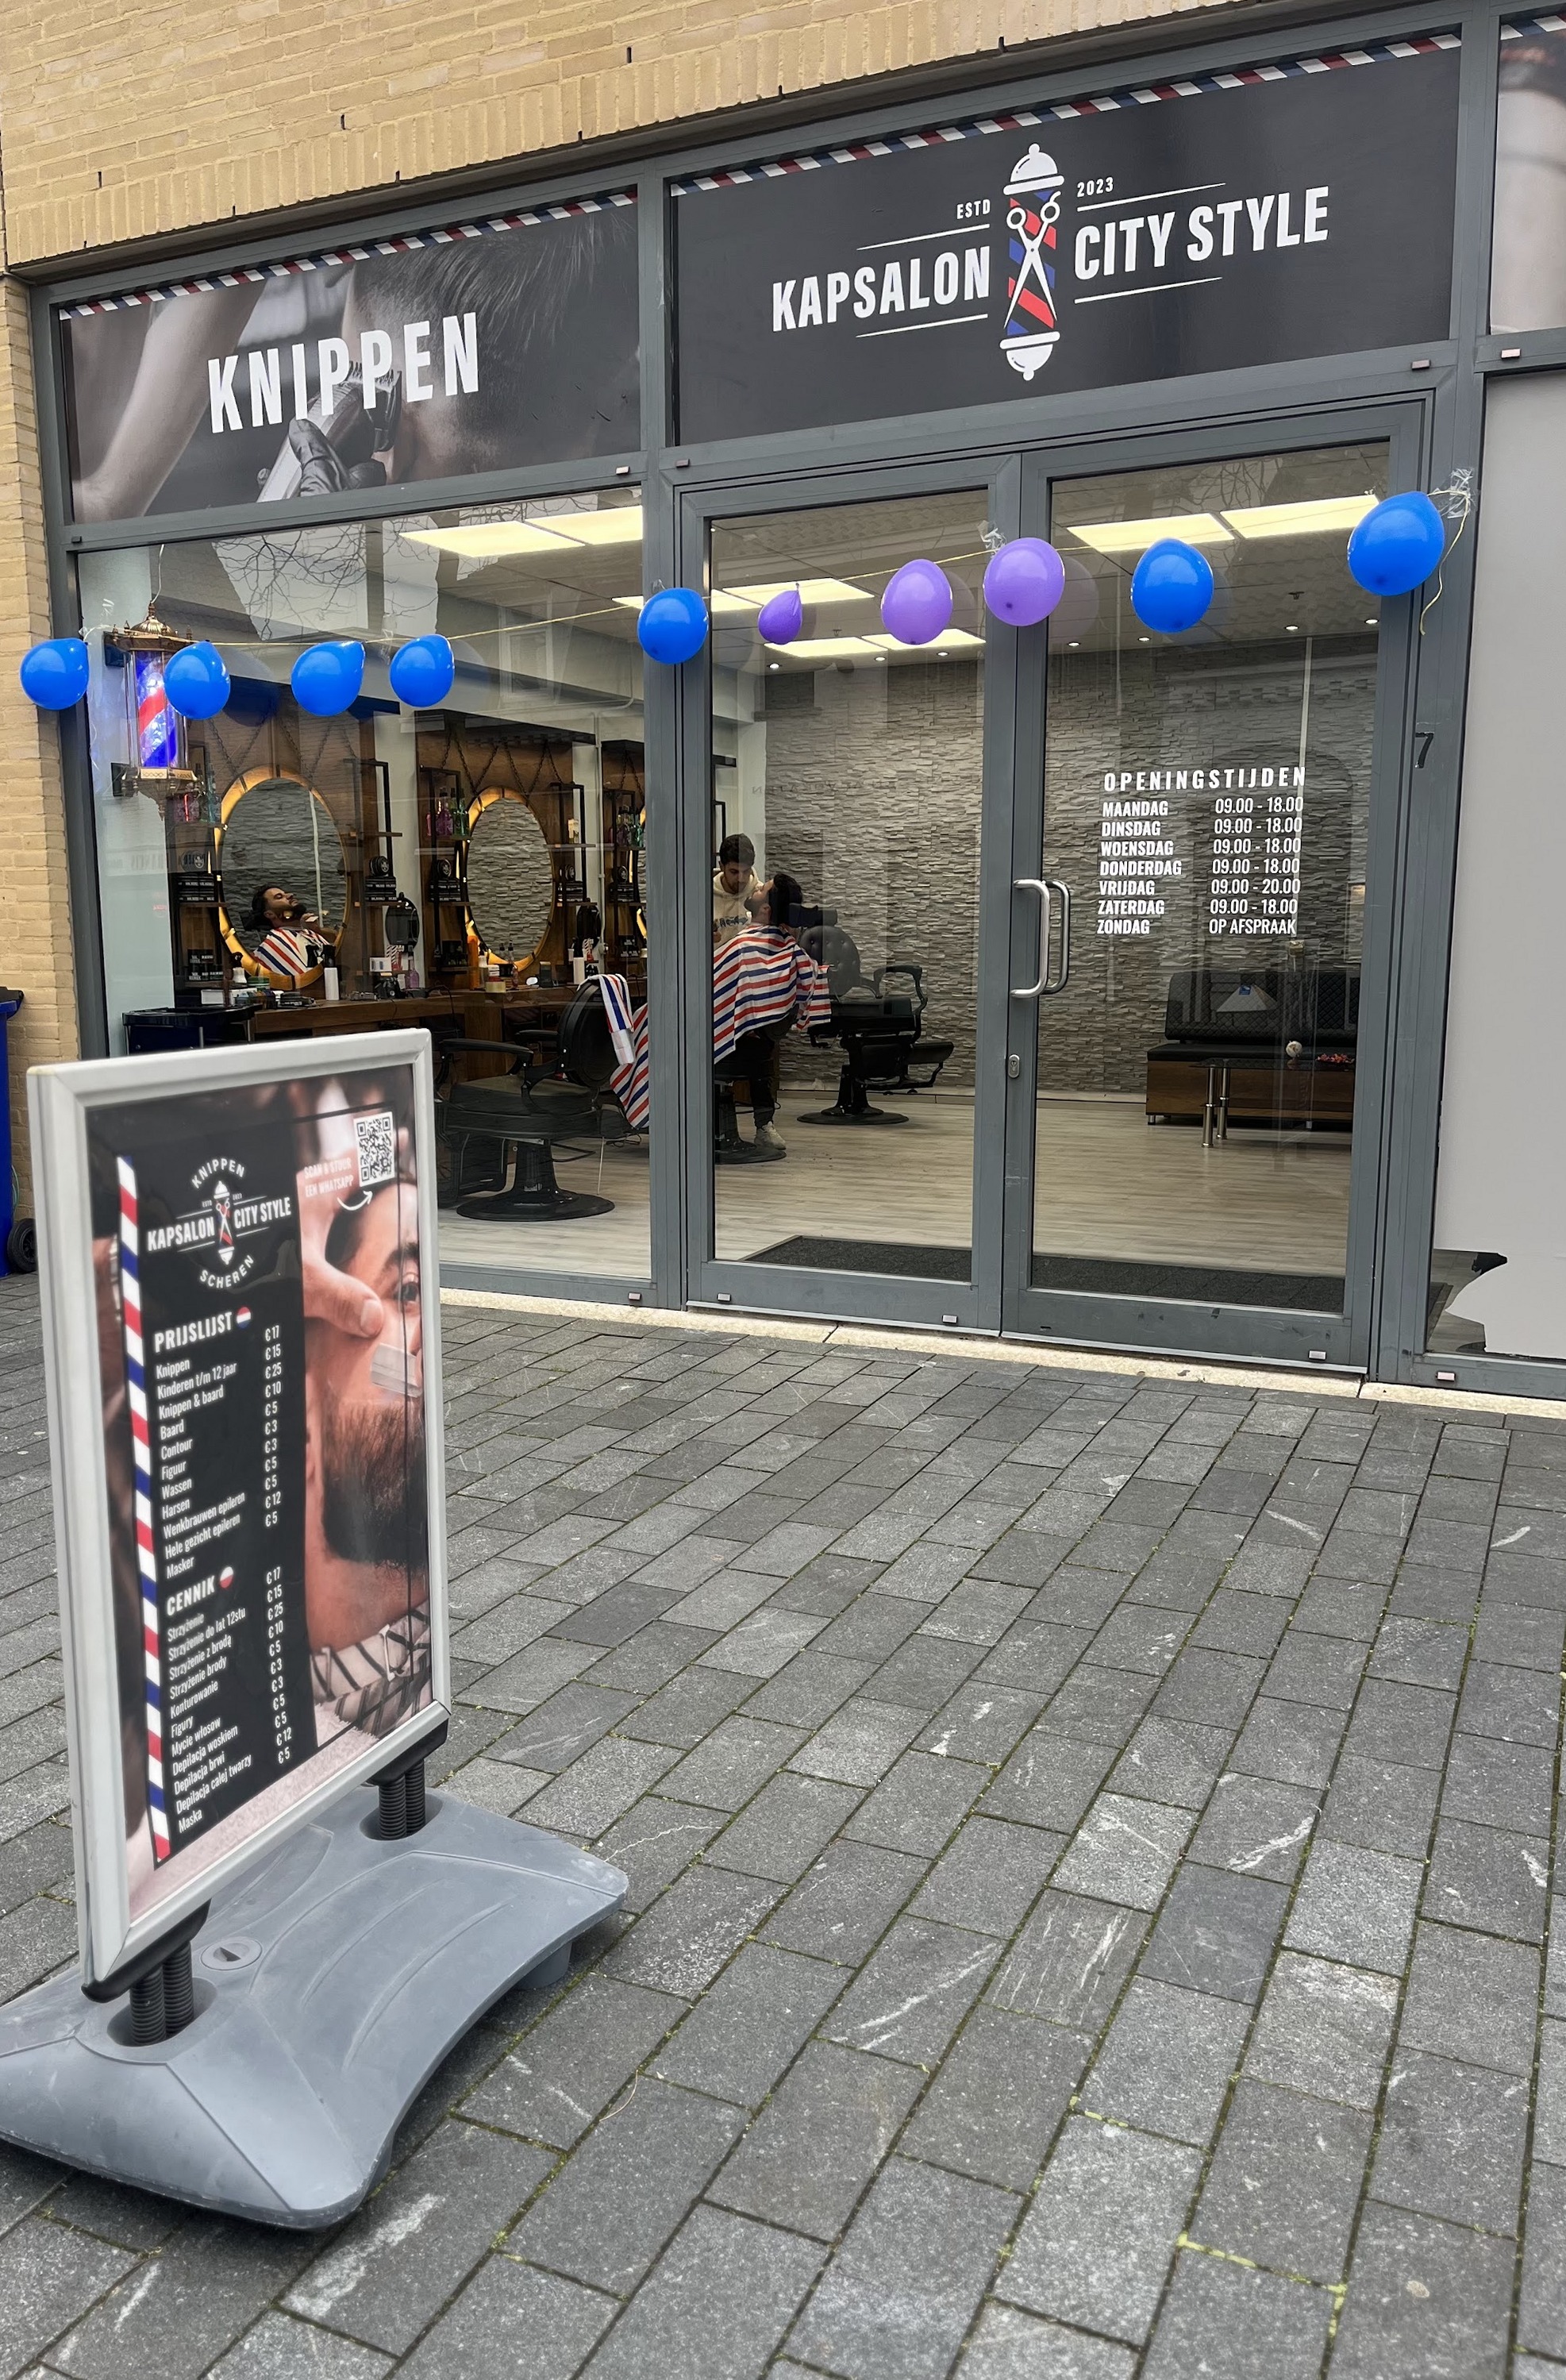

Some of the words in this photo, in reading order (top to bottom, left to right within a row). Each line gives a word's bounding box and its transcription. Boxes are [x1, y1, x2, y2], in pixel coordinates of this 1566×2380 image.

[956, 199, 991, 220] ESTD
[1076, 176, 1114, 197] 2023
[771, 245, 991, 332] KAPSALON
[1074, 211, 1175, 279] CITY
[1186, 186, 1329, 262] STYLE
[207, 312, 479, 433] KNIPPEN
[1415, 732, 1434, 768] 7
[1104, 767, 1305, 791] OPENINGSTIJDEN
[1102, 801, 1168, 817] MAANDAG
[1215, 798, 1253, 814] 09.00
[1267, 796, 1303, 812] 18.00
[1102, 821, 1160, 837] DINSDAG
[1214, 818, 1252, 834] 09.00
[1266, 817, 1302, 833] 18.00
[1101, 841, 1174, 856] WOENSDAG
[1213, 838, 1252, 854] 09.00
[1264, 838, 1301, 853] 18.00
[1100, 861, 1182, 876] DONDERDAG
[1212, 859, 1250, 874] 09.00
[1264, 858, 1300, 873] 18.00
[1099, 880, 1155, 895] VRIJDAG
[1211, 879, 1249, 894] 09.00
[1262, 879, 1300, 894] 20.00
[1099, 900, 1165, 915] ZATERDAG
[1210, 899, 1248, 915] 09.00
[1261, 899, 1298, 914] 18.00
[1097, 919, 1150, 934] ZONDAG
[1209, 919, 1226, 934] OP
[1229, 918, 1296, 934] AFSPRAAK
[191, 1157, 245, 1188] KNIPPEN
[318, 1174, 354, 1194] WHATSAPP
[148, 1216, 215, 1251] KAPSALON
[234, 1205, 258, 1229] CITY
[260, 1196, 291, 1222] STYLE
[200, 1254, 254, 1288] SCHEREN
[155, 1311, 233, 1353] PRIJSLIJST
[156, 1359, 190, 1379] Knippen
[158, 1378, 194, 1400] Kinderen
[195, 1372, 211, 1387] t/m
[212, 1365, 222, 1381] 12
[223, 1363, 237, 1379] jaar
[160, 1400, 192, 1419] Knippen
[194, 1393, 201, 1408] &
[202, 1384, 224, 1404] baard
[160, 1419, 184, 1440] Baard
[161, 1438, 193, 1460] Contour
[162, 1461, 187, 1481] Figuur
[162, 1478, 192, 1500] Wassen
[163, 1499, 190, 1520] Harsen
[164, 1507, 217, 1539] Wenkbrauwen
[218, 1492, 245, 1515] epileren
[165, 1541, 183, 1559] Hele
[184, 1527, 211, 1553] gezicht
[213, 1514, 240, 1538] epileren
[167, 1557, 194, 1579] Masker
[167, 1575, 215, 1616] CENNIK
[206, 1625, 215, 1639] do
[216, 1618, 225, 1633] lat
[227, 1608, 246, 1627] 12stu
[206, 1648, 211, 1658] z
[211, 1634, 232, 1655] brodą
[170, 1669, 206, 1700] Strzyżenie
[207, 1656, 227, 1677] brody
[171, 1681, 219, 1720] Konturowanie
[171, 1716, 194, 1739] Figury
[171, 1736, 194, 1758] Mycie
[172, 1746, 206, 1776] Depilacja
[207, 1726, 238, 1753] woskiem
[174, 1765, 208, 1796] Depilacja
[209, 1750, 225, 1772] brwi
[175, 1784, 210, 1815] Depilacja
[229, 1754, 252, 1777] twarzy
[178, 1809, 202, 1834] Maska
